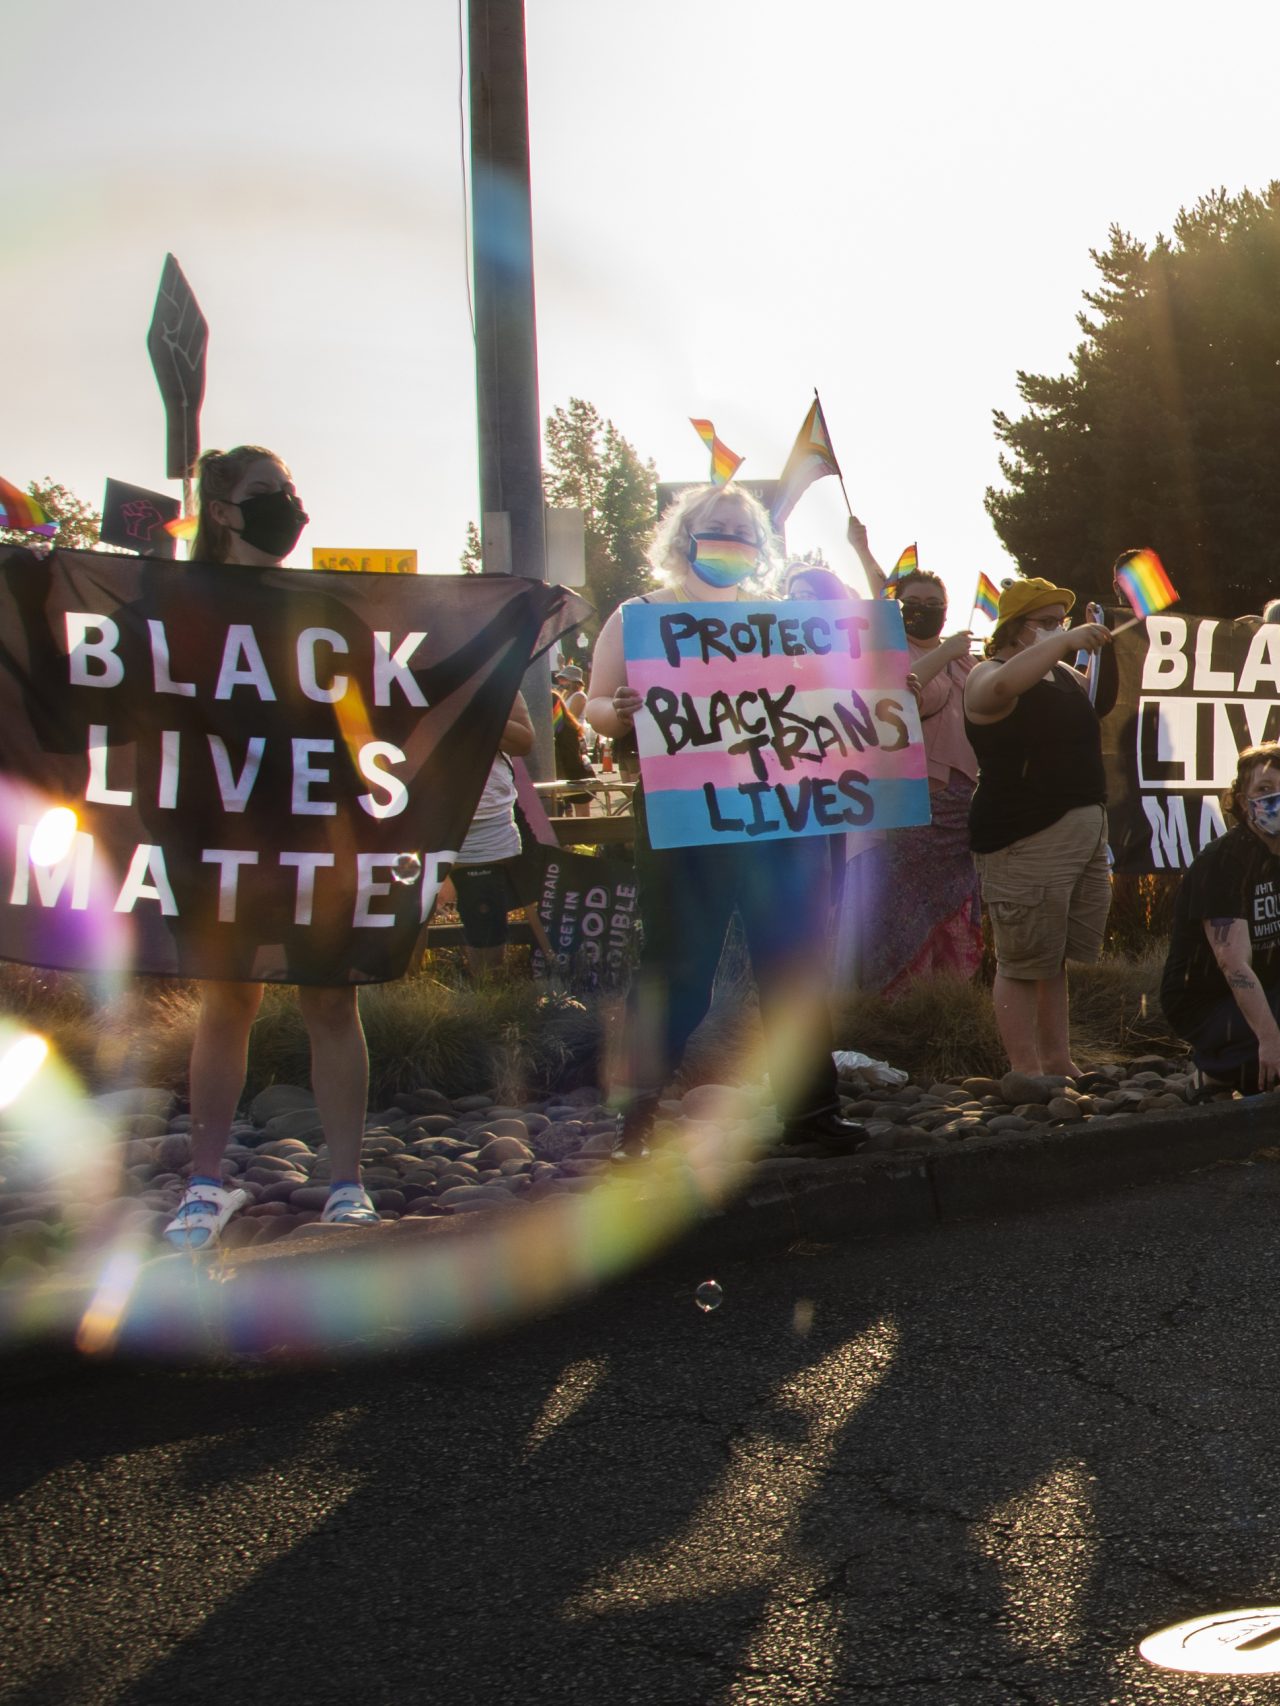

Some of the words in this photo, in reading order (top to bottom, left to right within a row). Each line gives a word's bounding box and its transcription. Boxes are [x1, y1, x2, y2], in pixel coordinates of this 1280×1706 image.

[66, 611, 430, 708] BLACK
[659, 612, 870, 668] PROTECT
[645, 684, 816, 755] BLACK
[728, 689, 910, 782] TRANS
[85, 724, 409, 819] LIVES
[703, 769, 875, 836] LIVES
[540, 863, 560, 921] AFRAID
[563, 890, 581, 910] IN
[560, 913, 577, 947] GET
[606, 884, 637, 984] OUBLE
